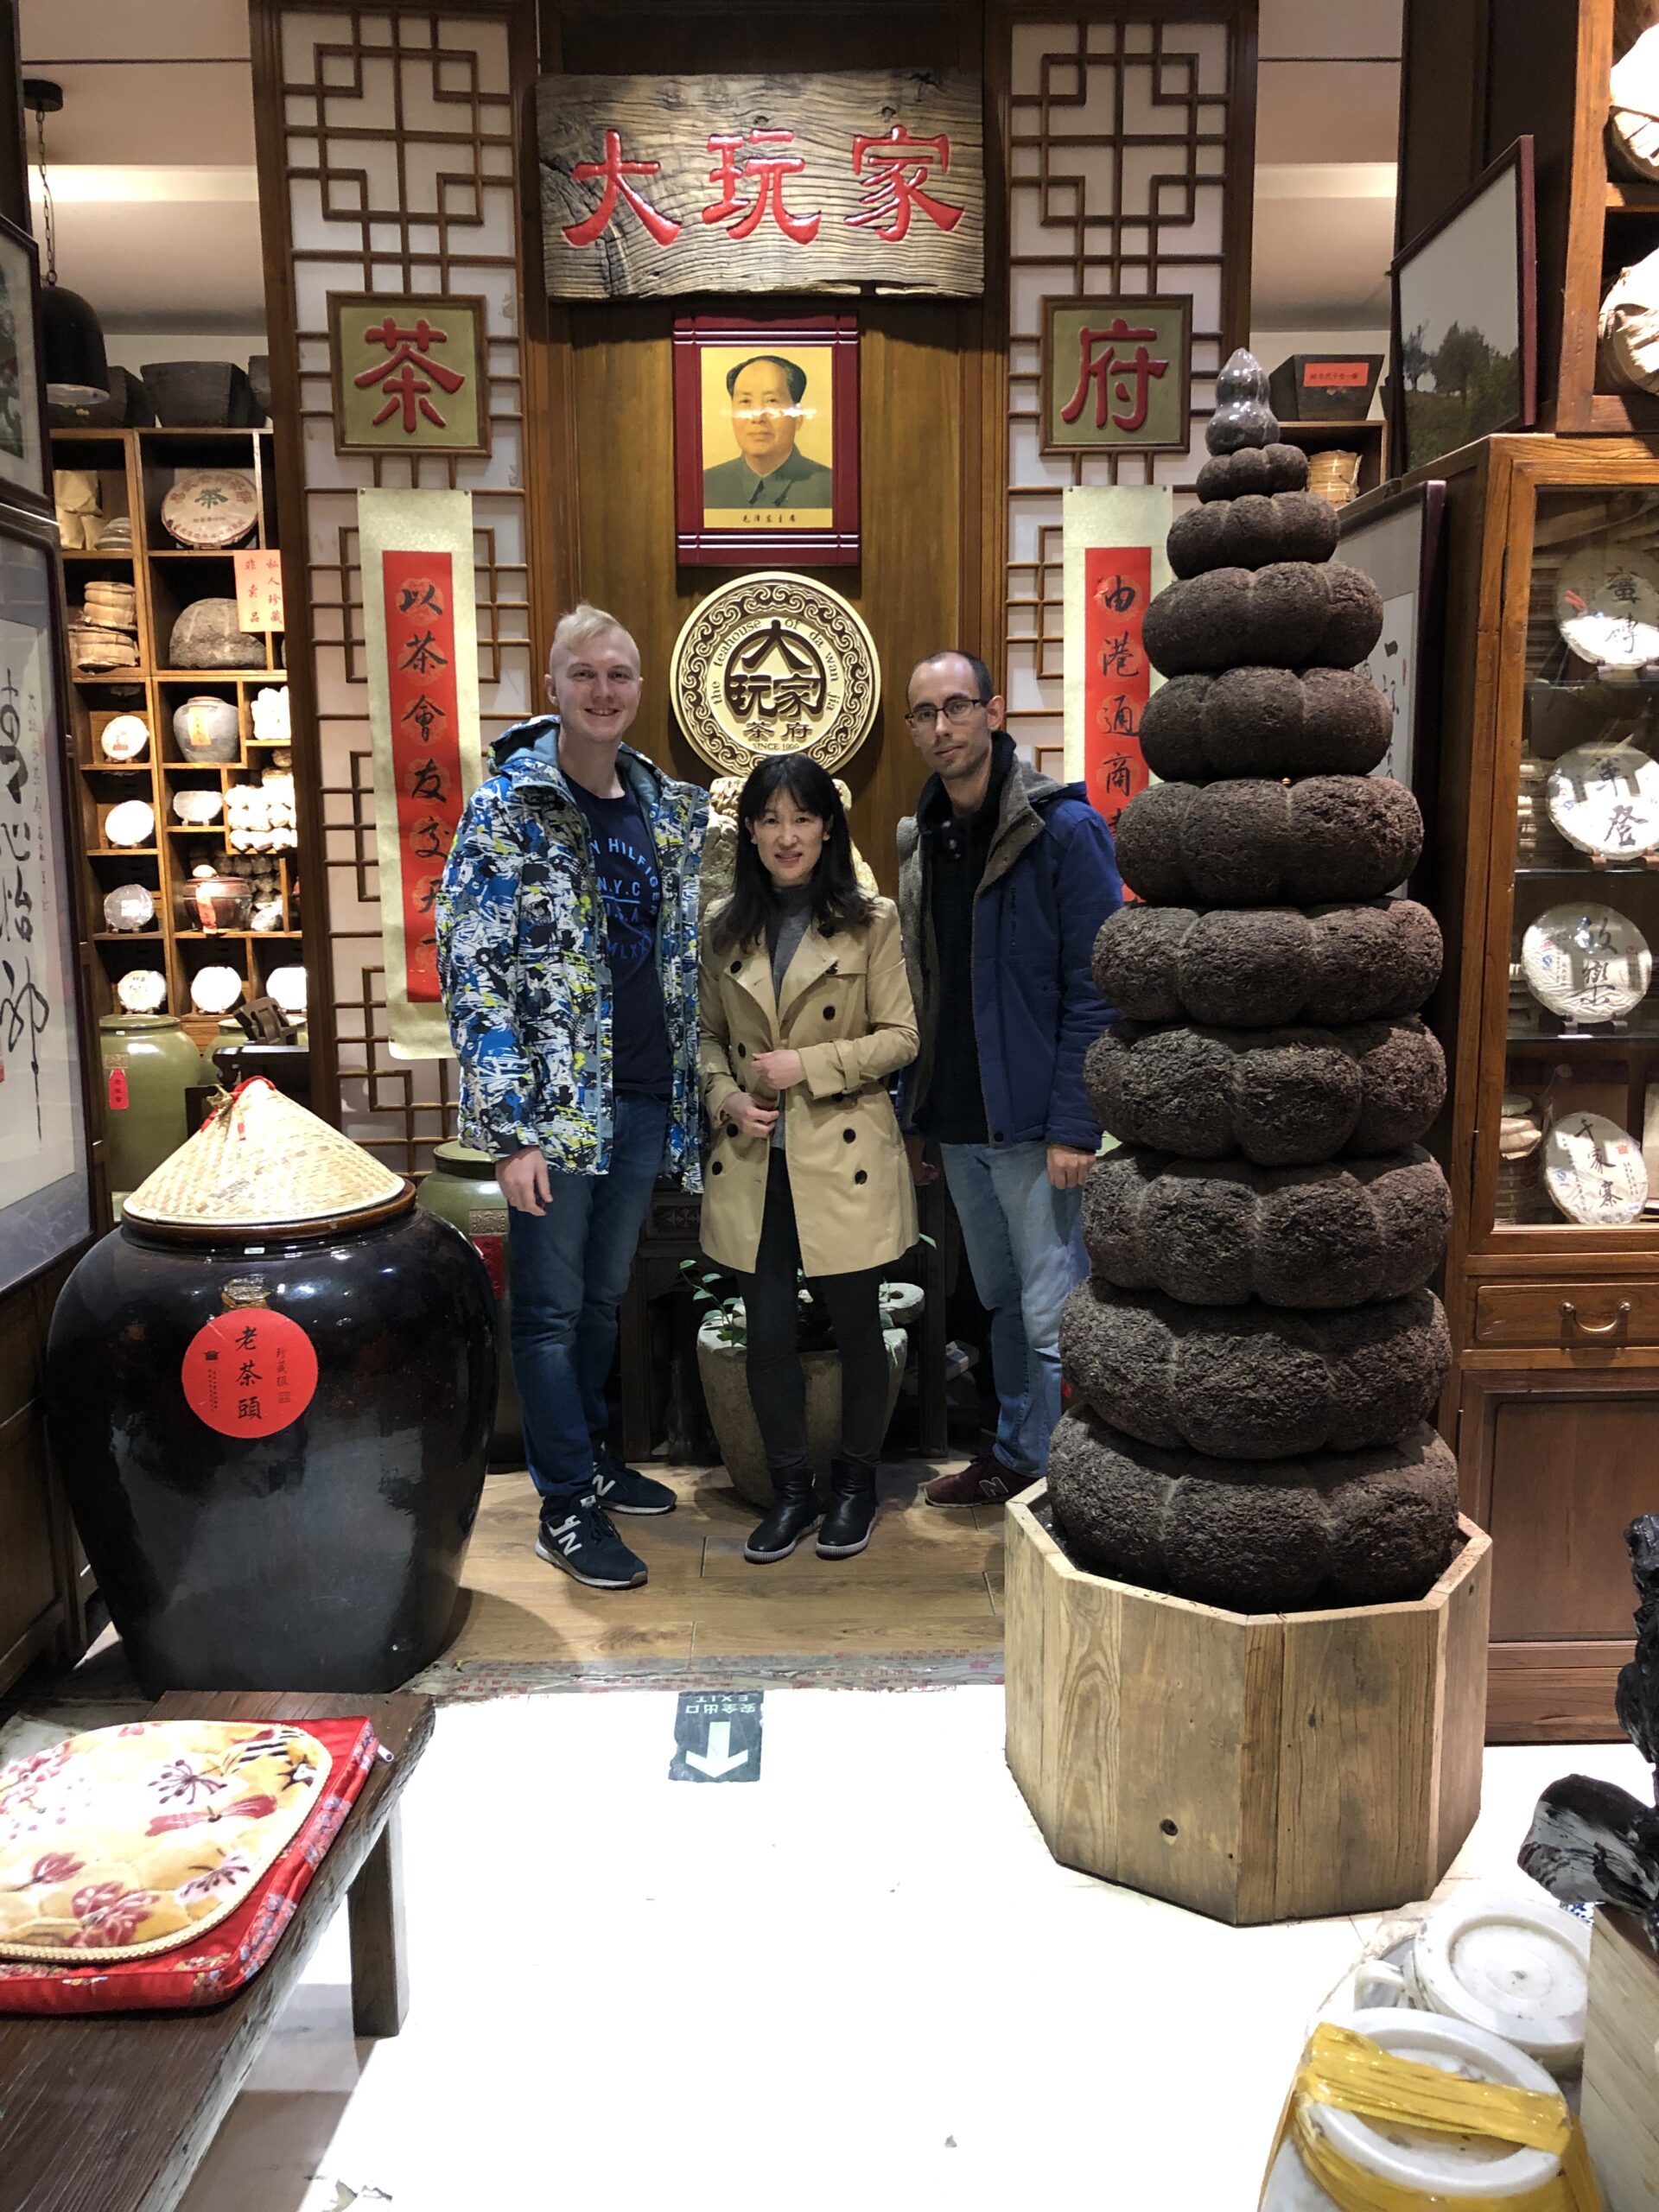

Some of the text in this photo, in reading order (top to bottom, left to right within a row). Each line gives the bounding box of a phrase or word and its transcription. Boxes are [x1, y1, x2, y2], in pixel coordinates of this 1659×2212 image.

[562, 125, 965, 247] 大玩家
[353, 315, 467, 434] 茶
[1060, 318, 1169, 432] 府
[712, 618, 842, 713] the teahouse of da wan jia
[398, 588, 448, 945] 以茶會友交
[743, 721, 813, 740] 茶府
[752, 742, 779, 751] SINCE
[607, 837, 660, 916] HILFIGER
[235, 1325, 263, 1420] 老茶頭
[685, 1703, 756, 1715] 安全出口
[696, 1694, 749, 1703] EXIT
